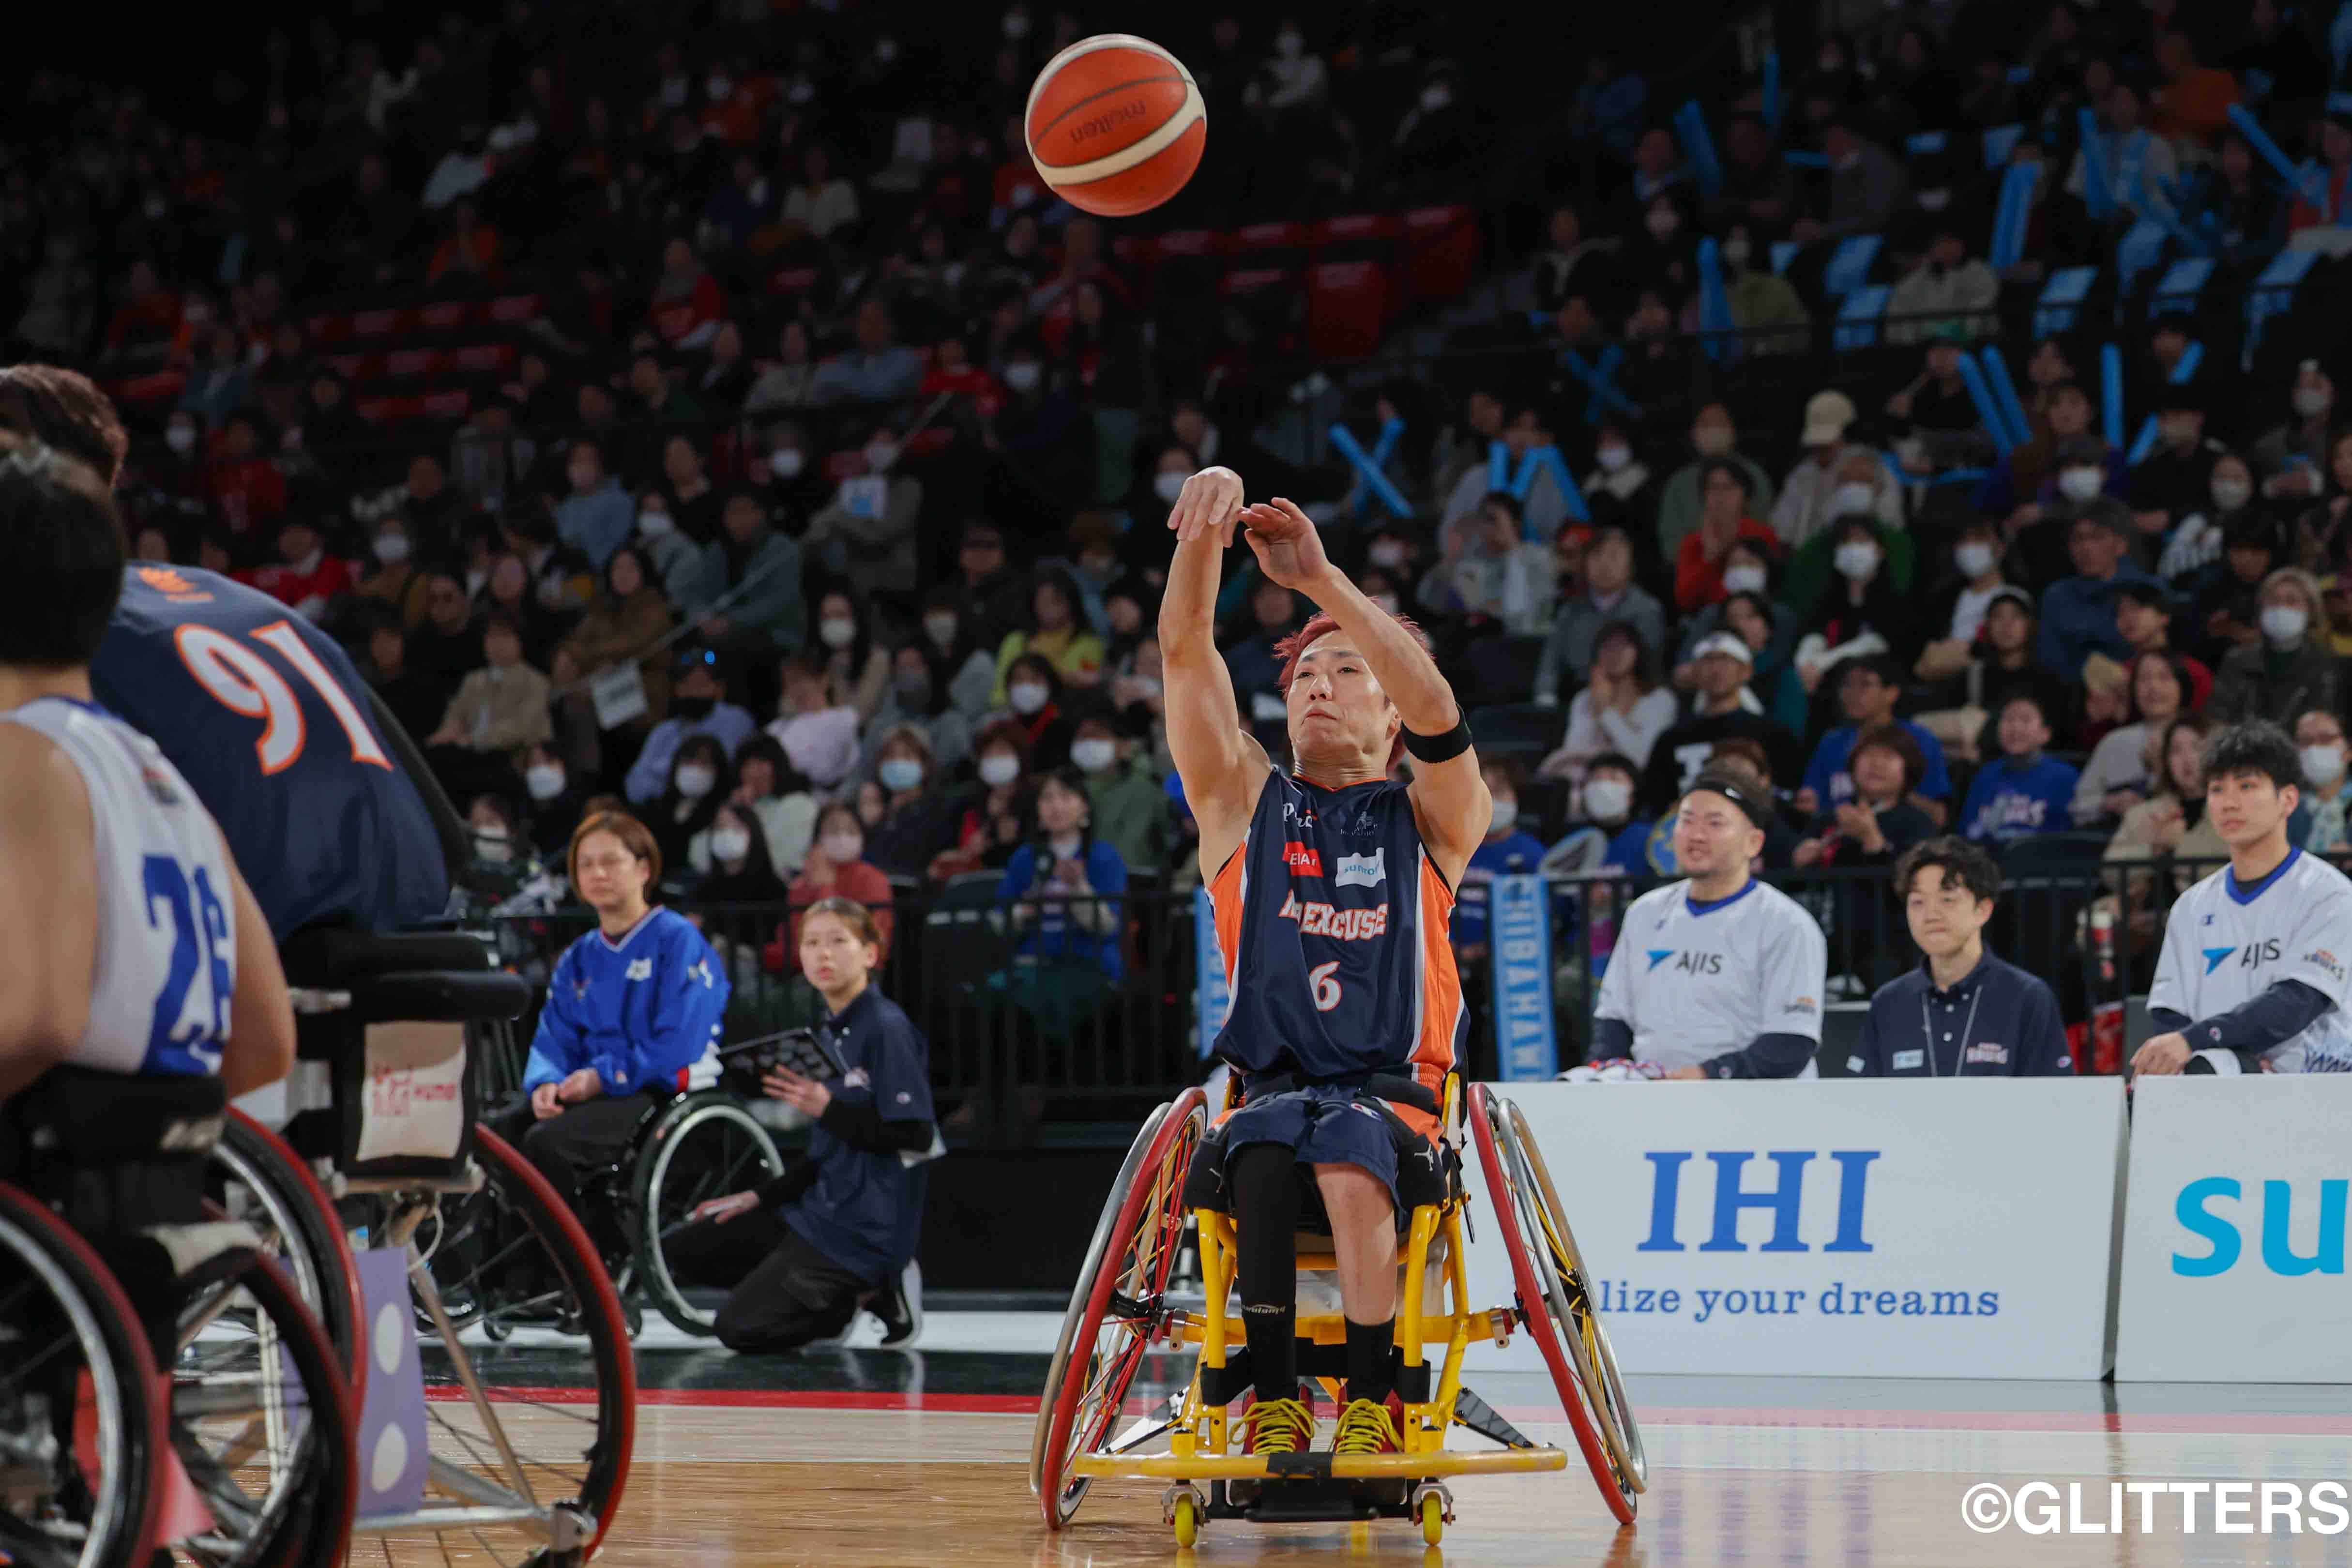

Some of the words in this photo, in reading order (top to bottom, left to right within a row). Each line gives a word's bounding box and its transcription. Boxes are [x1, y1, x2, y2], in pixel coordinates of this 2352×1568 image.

[173, 620, 395, 776] 91
[1308, 960, 1343, 1012] 6
[1637, 1150, 1881, 1253] IHI
[2171, 1176, 2351, 1278] su
[1599, 1280, 1681, 1313] lize
[1694, 1289, 1806, 1323] your
[1819, 1281, 2000, 1317] dreams
